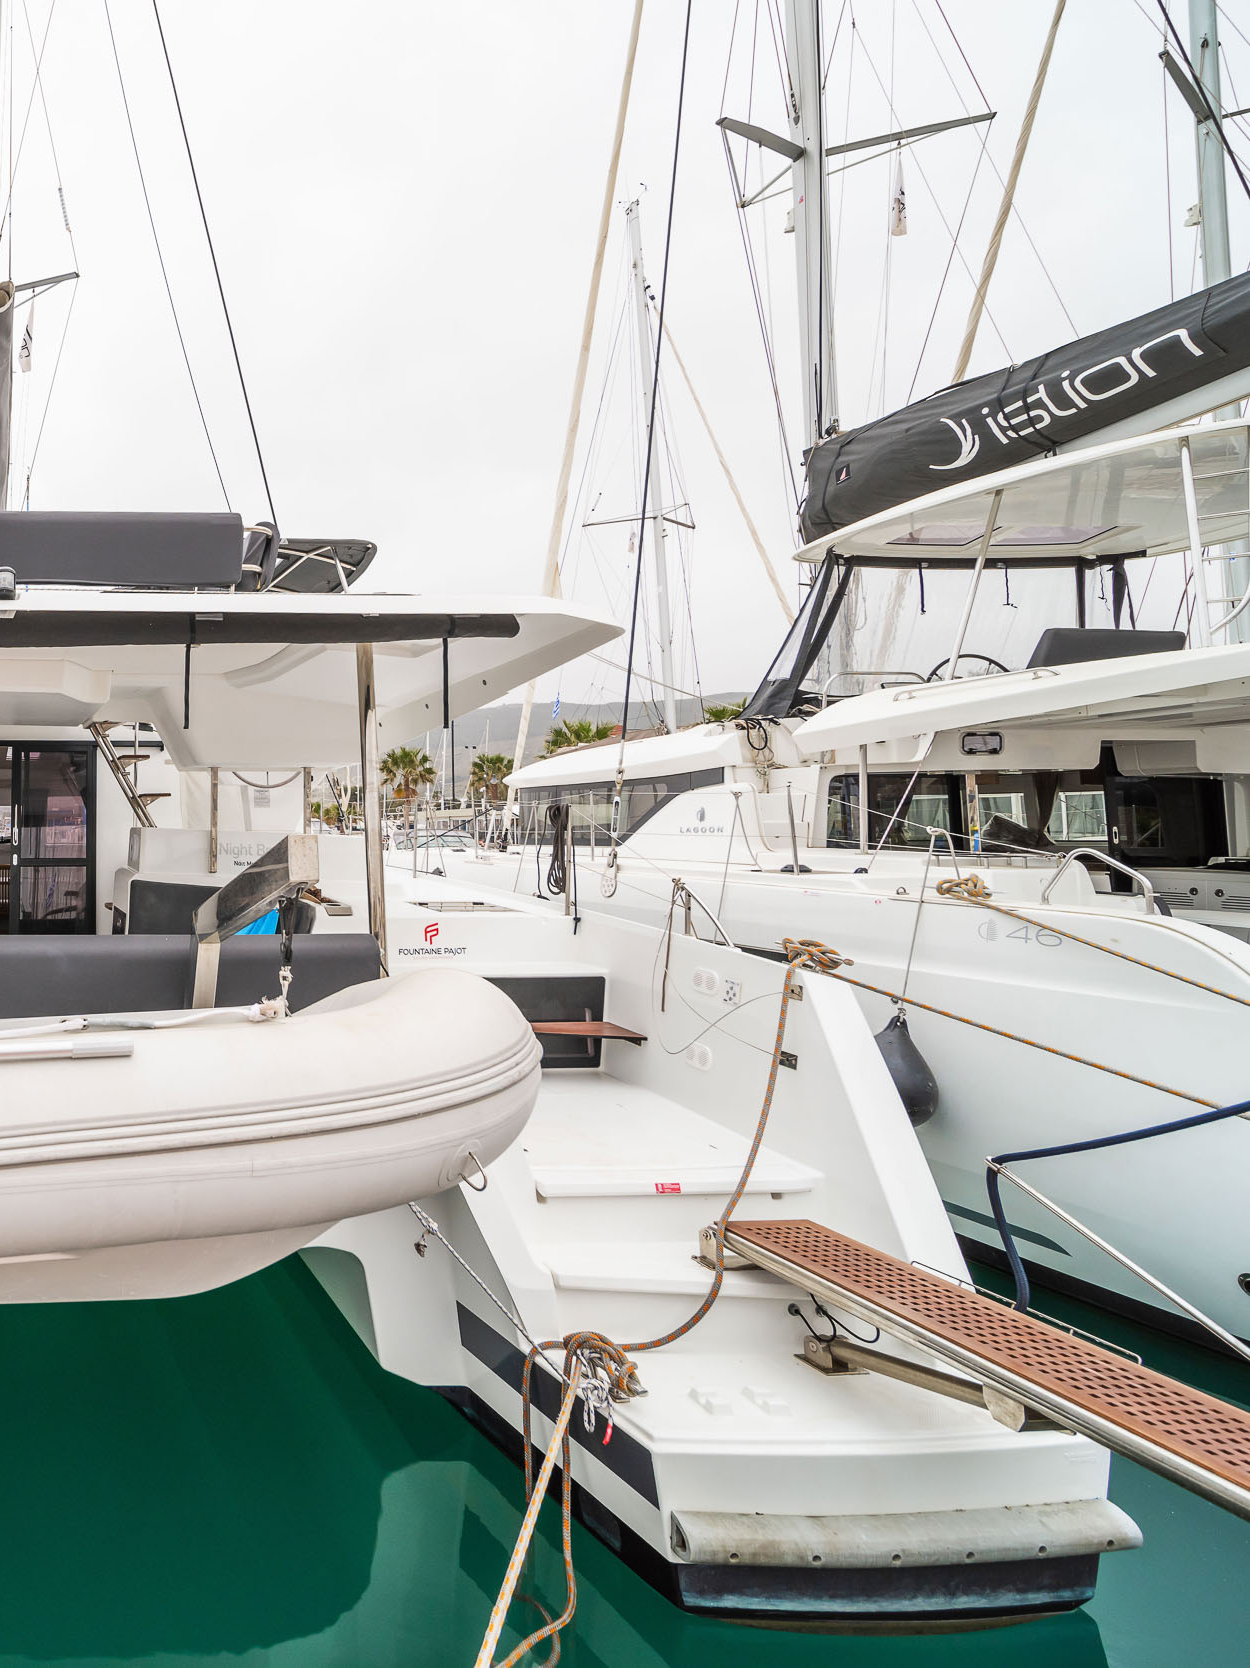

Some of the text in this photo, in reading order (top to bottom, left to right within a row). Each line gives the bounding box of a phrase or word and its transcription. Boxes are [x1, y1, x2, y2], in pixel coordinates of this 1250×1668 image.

[981, 327, 1205, 445] istion
[679, 826, 724, 834] LAGOON
[218, 842, 253, 859] Night
[1005, 925, 1063, 948] 46
[398, 947, 467, 956] FOUNTAINE PAJOT
